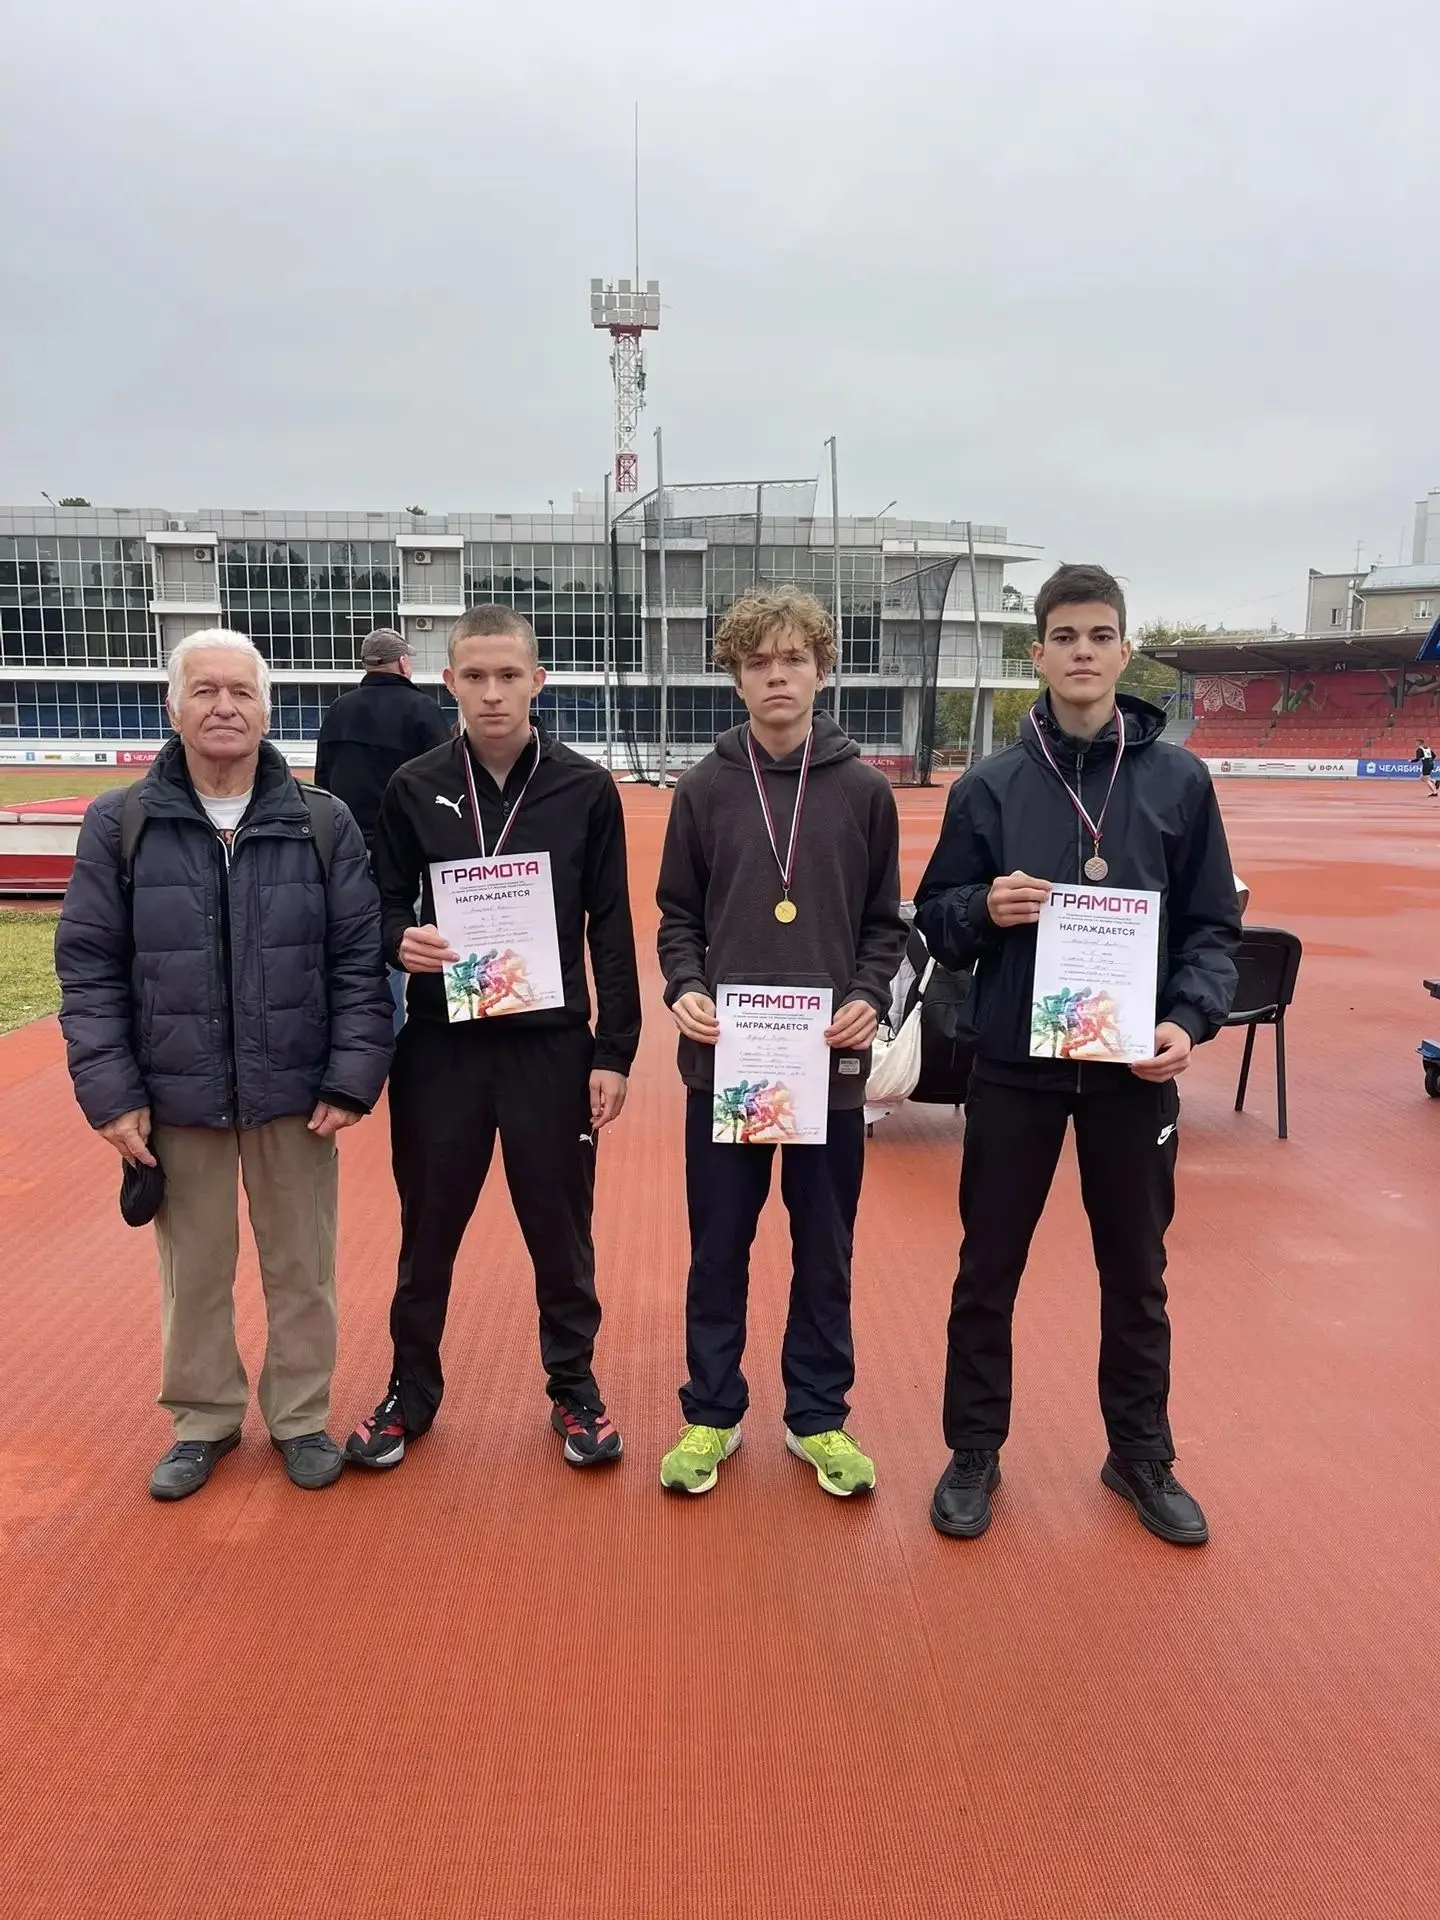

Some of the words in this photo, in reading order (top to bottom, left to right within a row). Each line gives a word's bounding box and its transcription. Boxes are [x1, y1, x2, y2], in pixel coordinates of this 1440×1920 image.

[1378, 764, 1440, 773] ЧЕЛЯБИНА
[441, 861, 539, 884] ГРАМОТА
[455, 889, 531, 904] НАГРАЖДАЕТСЯ
[1050, 892, 1148, 915] ГРАМОТА
[1060, 923, 1136, 937] НАГРАЖДАЕТСЯ
[726, 993, 821, 1010] ГРАМОТА
[736, 1021, 809, 1031] НАГРАЖДАЕТСЯ
